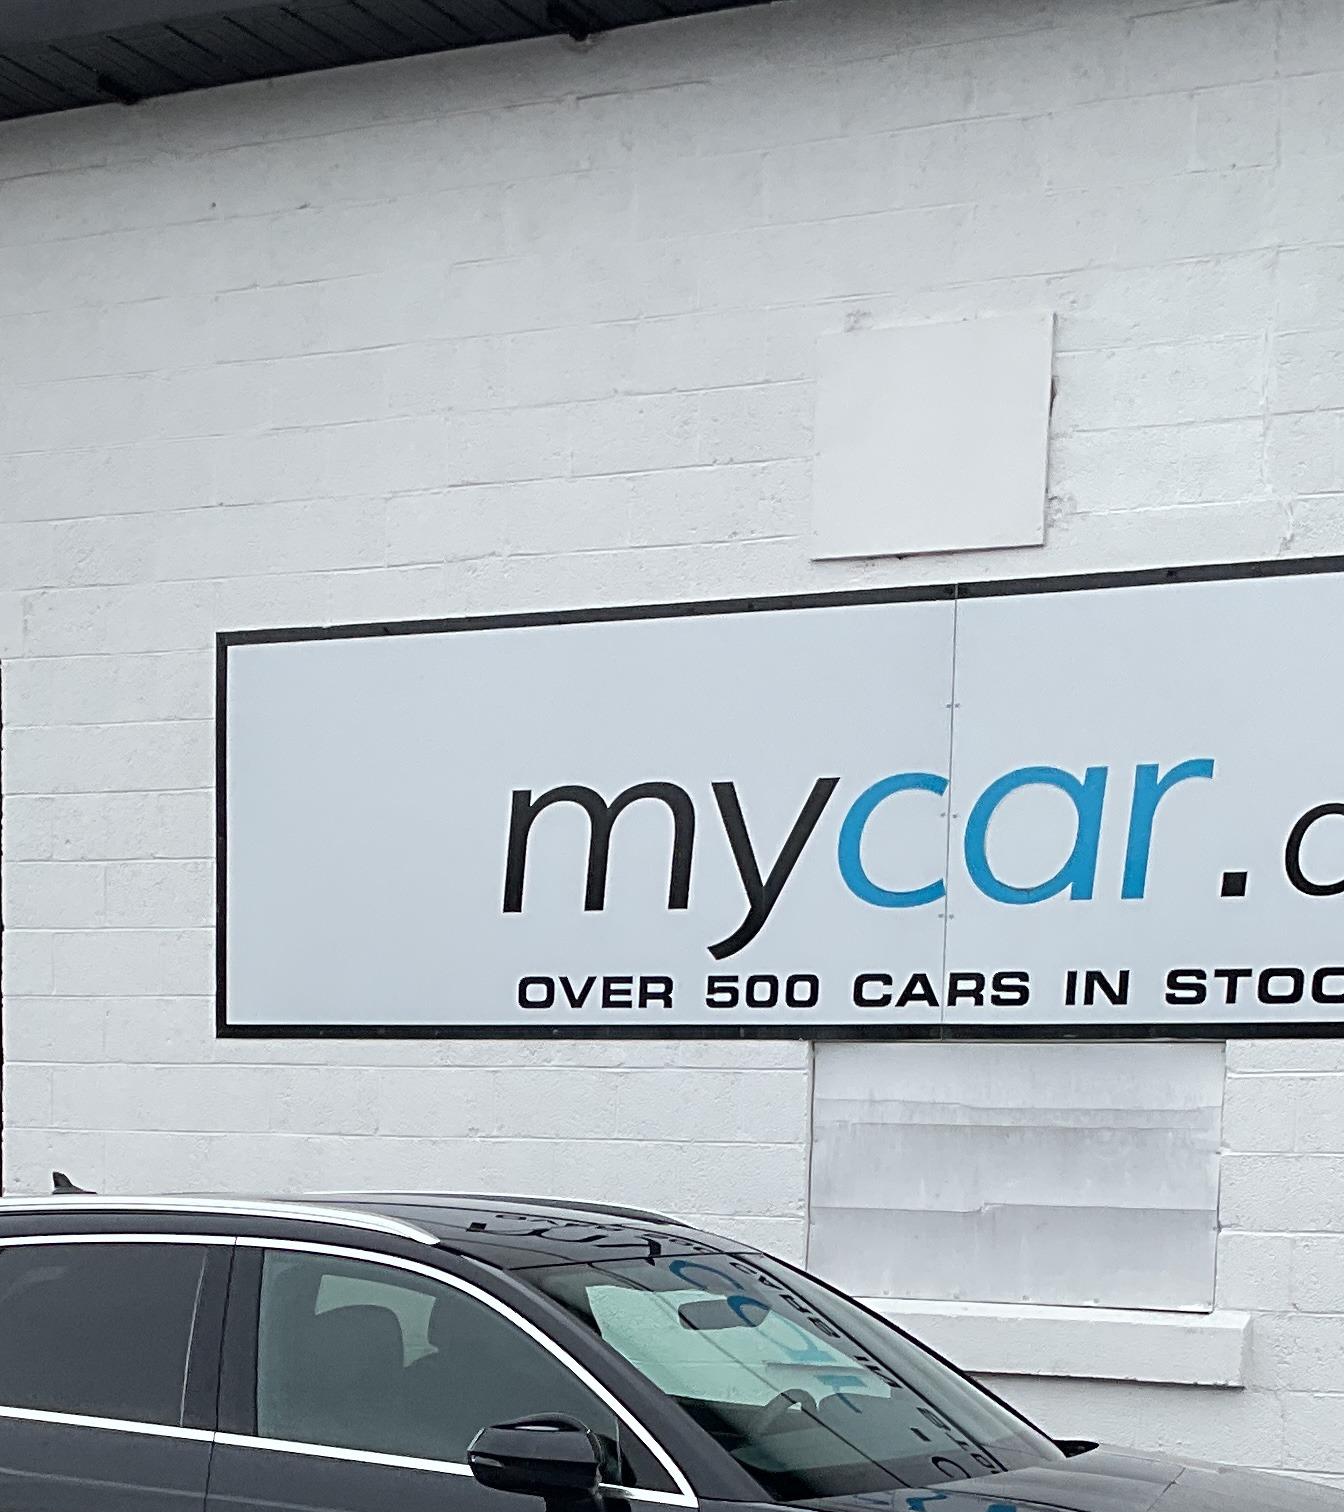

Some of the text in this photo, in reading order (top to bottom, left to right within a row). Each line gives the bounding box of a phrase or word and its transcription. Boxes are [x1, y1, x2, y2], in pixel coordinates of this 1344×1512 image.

[518, 975, 674, 1009] OVER
[705, 973, 819, 1008] 500
[853, 971, 1029, 1008] CARS
[1065, 970, 1130, 1006] IN
